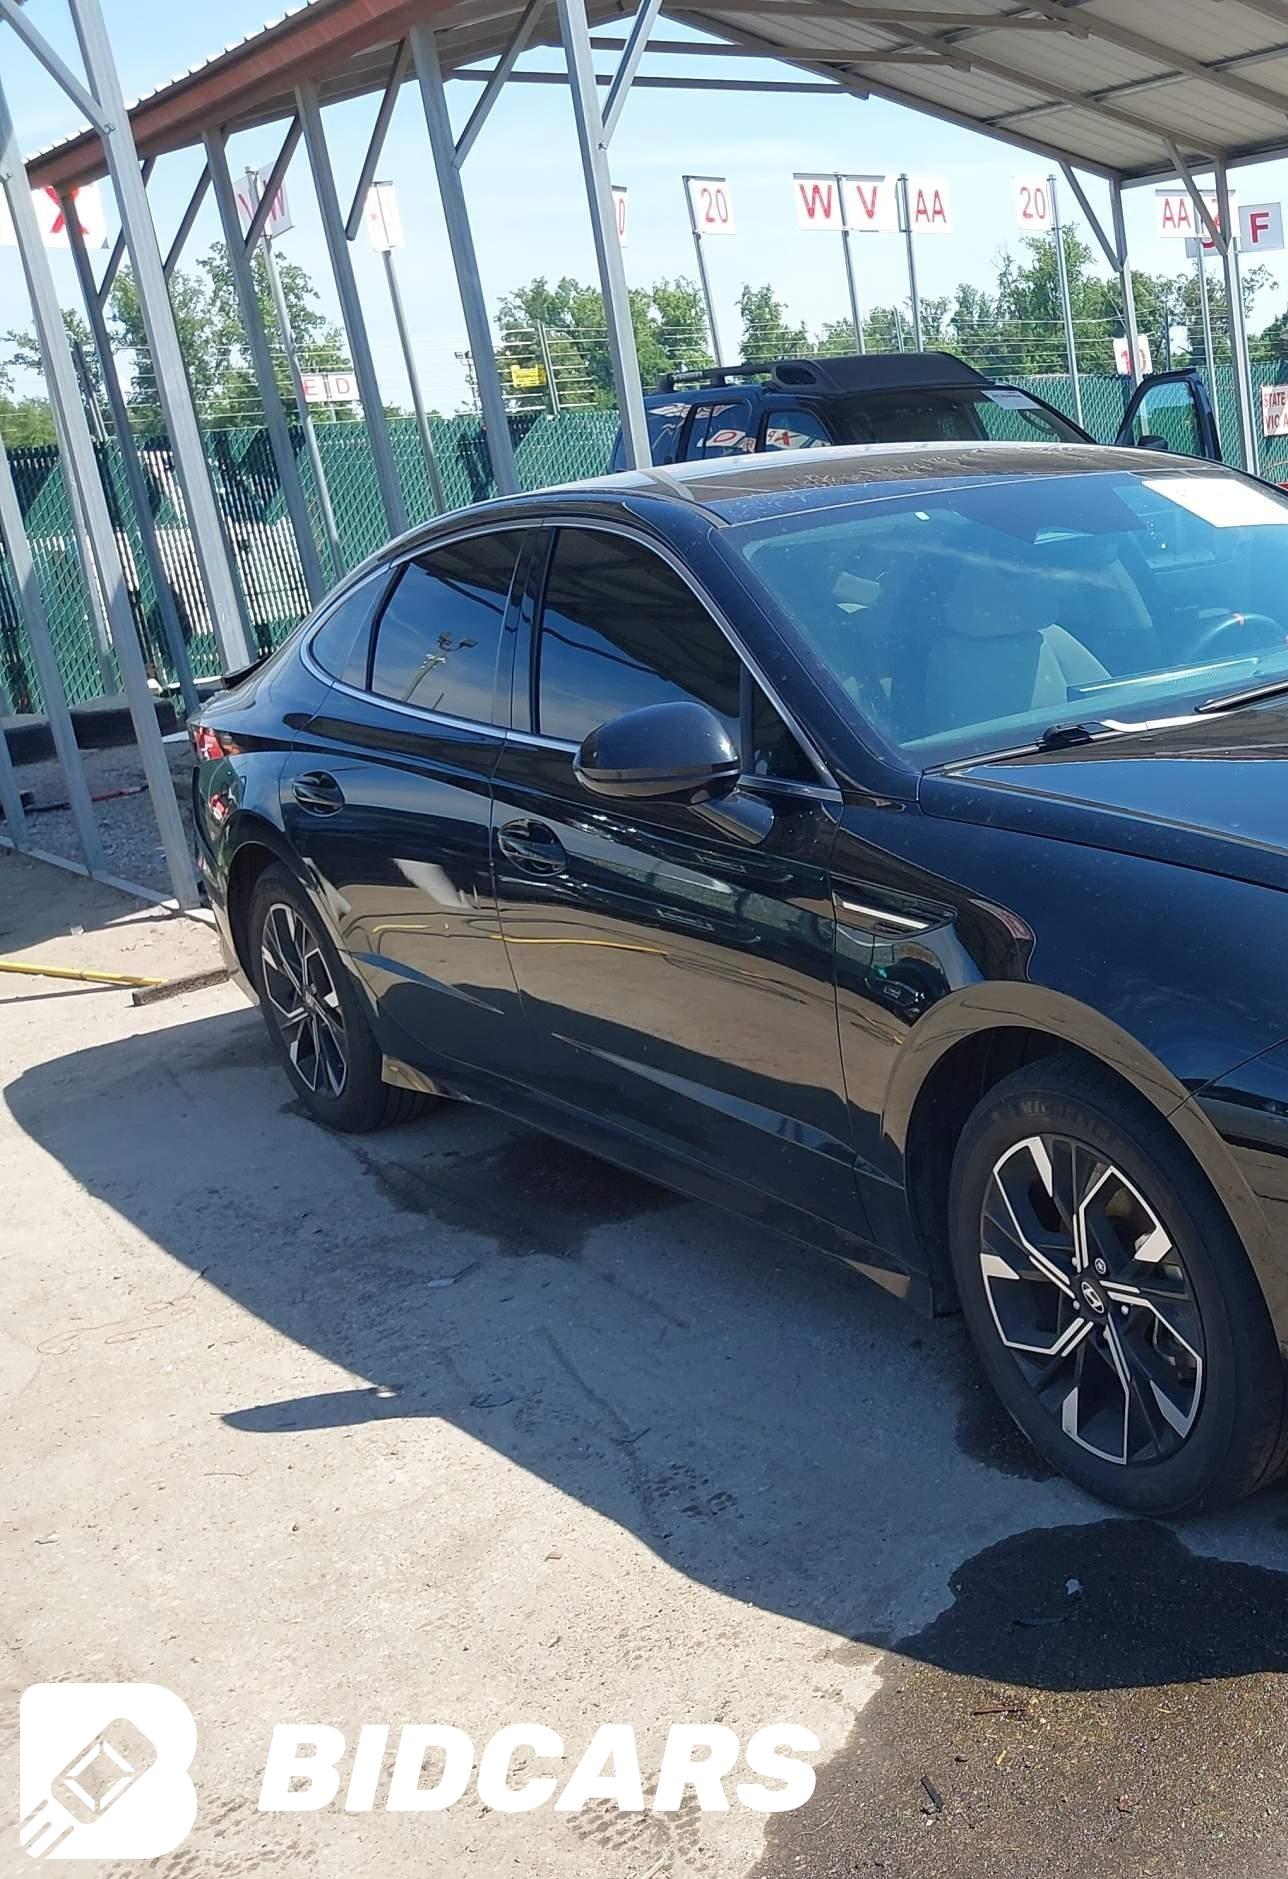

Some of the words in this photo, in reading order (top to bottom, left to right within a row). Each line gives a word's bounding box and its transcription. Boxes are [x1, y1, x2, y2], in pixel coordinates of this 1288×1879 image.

[701, 188, 728, 223] 20
[799, 184, 832, 218] W
[857, 186, 877, 218] V
[915, 189, 947, 223] AA
[1019, 187, 1046, 219] 20
[1163, 198, 1191, 229] AA
[1250, 212, 1270, 243] F
[304, 379, 319, 396] E
[336, 377, 350, 394] D
[1264, 391, 1285, 407] STATE
